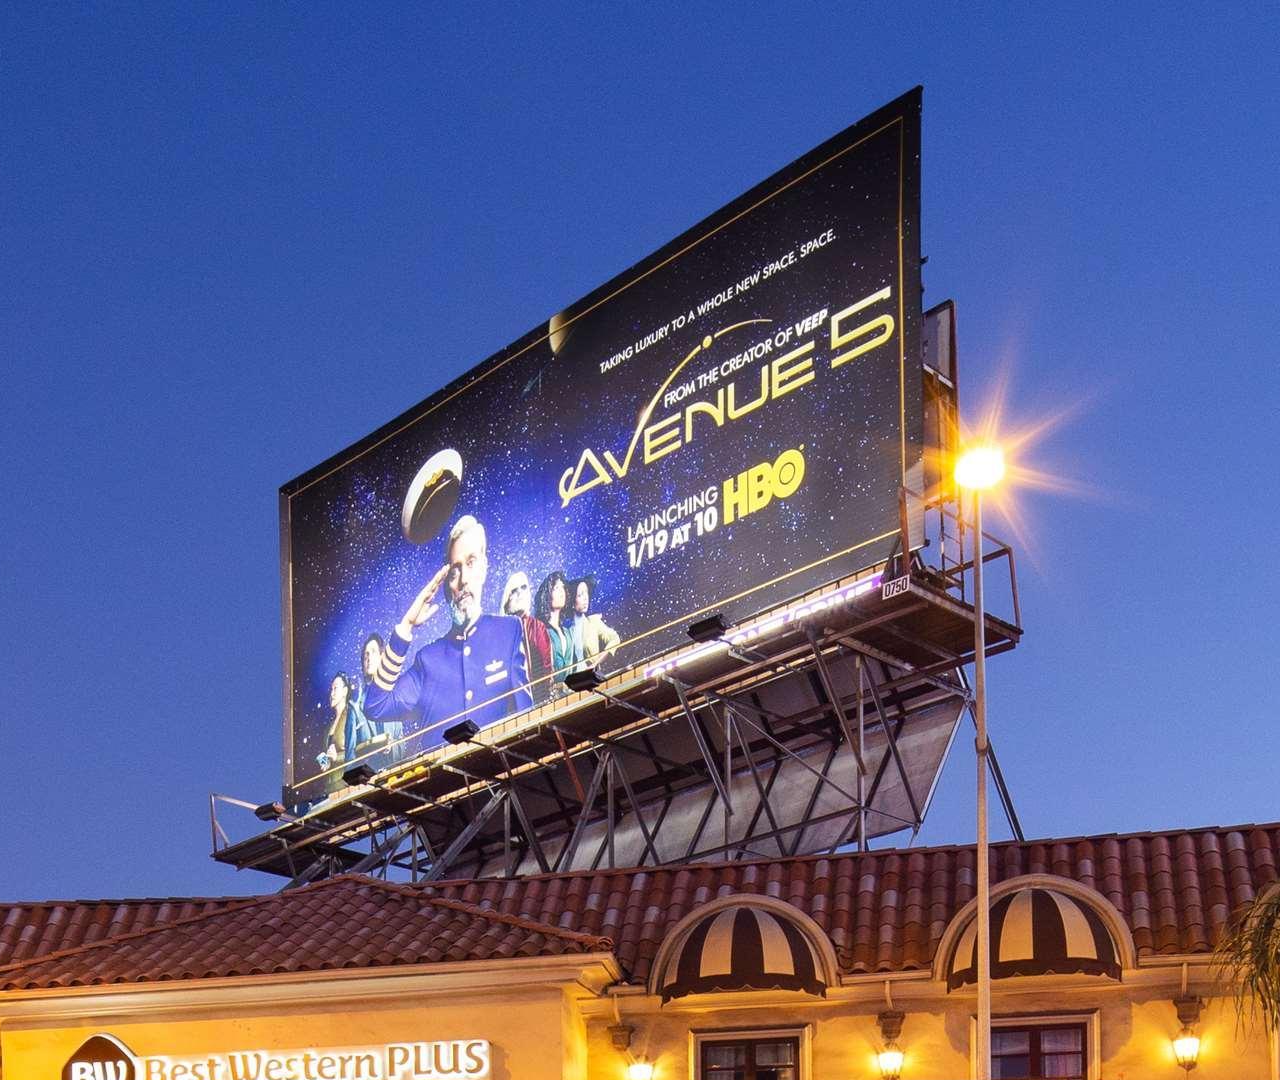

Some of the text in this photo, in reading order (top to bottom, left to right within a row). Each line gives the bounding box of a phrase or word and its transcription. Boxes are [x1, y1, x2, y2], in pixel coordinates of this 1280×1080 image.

[600, 228, 837, 374] TAKING LUXURY TO A WHOLE NEW SPACE. SPACE.
[664, 308, 829, 408] FROM THE CREATOR OF VEEP
[559, 286, 896, 508] AVENUE 5
[627, 486, 719, 543] LAUNCHING
[723, 447, 806, 526] HBO
[627, 506, 719, 569] 1/19 AT 10
[884, 577, 908, 598] 0750
[387, 1040, 487, 1077] PLUS
